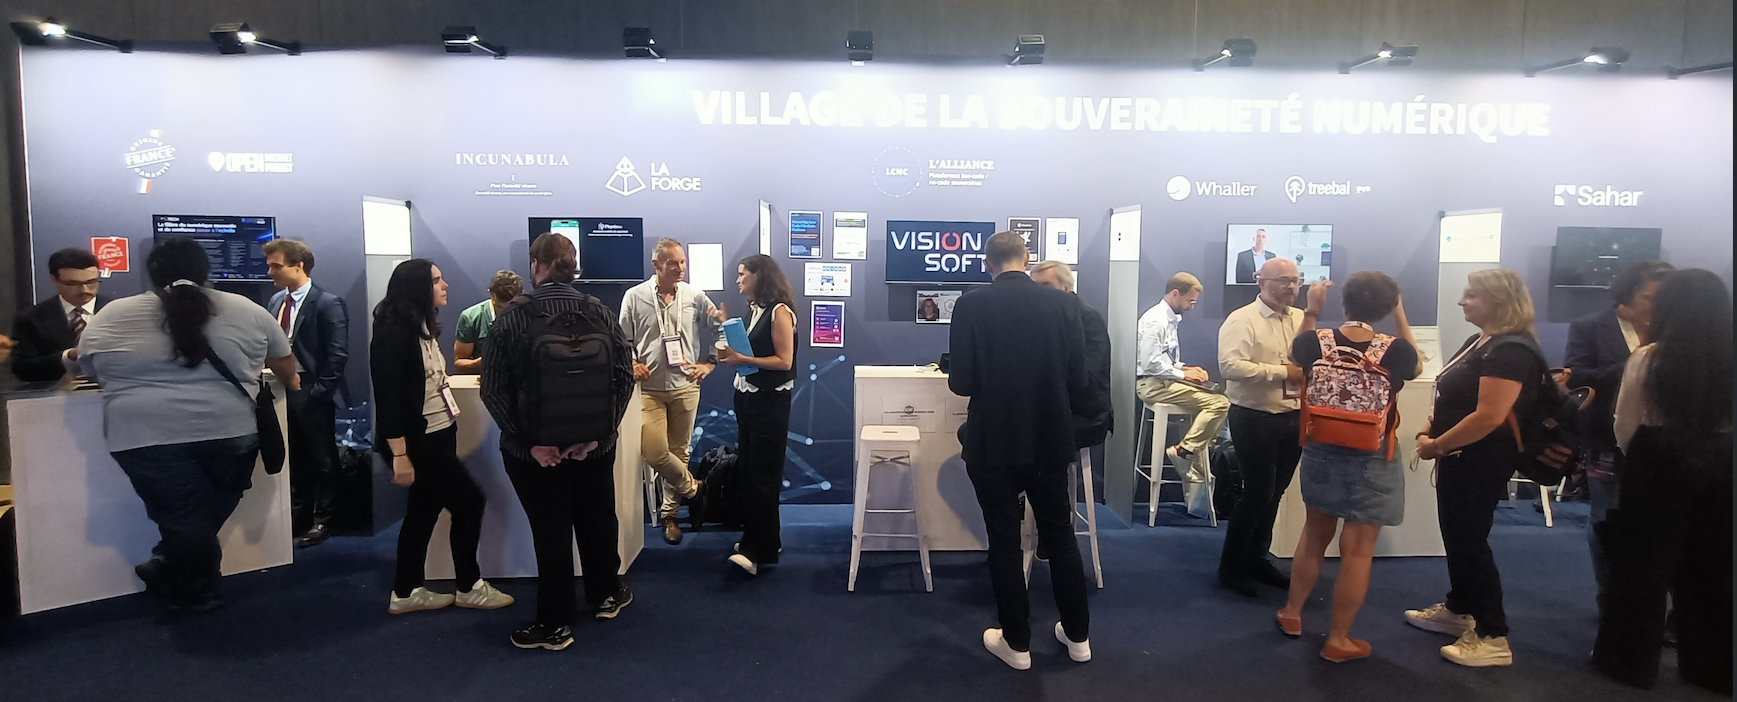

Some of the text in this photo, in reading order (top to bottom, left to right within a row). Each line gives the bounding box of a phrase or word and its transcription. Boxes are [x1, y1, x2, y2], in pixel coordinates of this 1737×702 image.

[692, 90, 1552, 144] VILLAGE DE LA SOUVERAINETÉ NUMÉRIQUE
[130, 137, 163, 151] ORIGINE
[125, 149, 174, 166] FRANCE
[226, 152, 265, 173] OPEN
[455, 153, 570, 166] INCUNABULA
[928, 159, 995, 170] L'ALLIANCE
[650, 162, 671, 176] LA
[885, 168, 909, 176] LCNC
[651, 176, 702, 192] FORGE
[1195, 181, 1258, 196] Whaller
[1307, 180, 1351, 196] treebal
[1577, 184, 1643, 207] Sahar
[890, 231, 982, 251] VISION
[924, 253, 987, 273] SOFT
